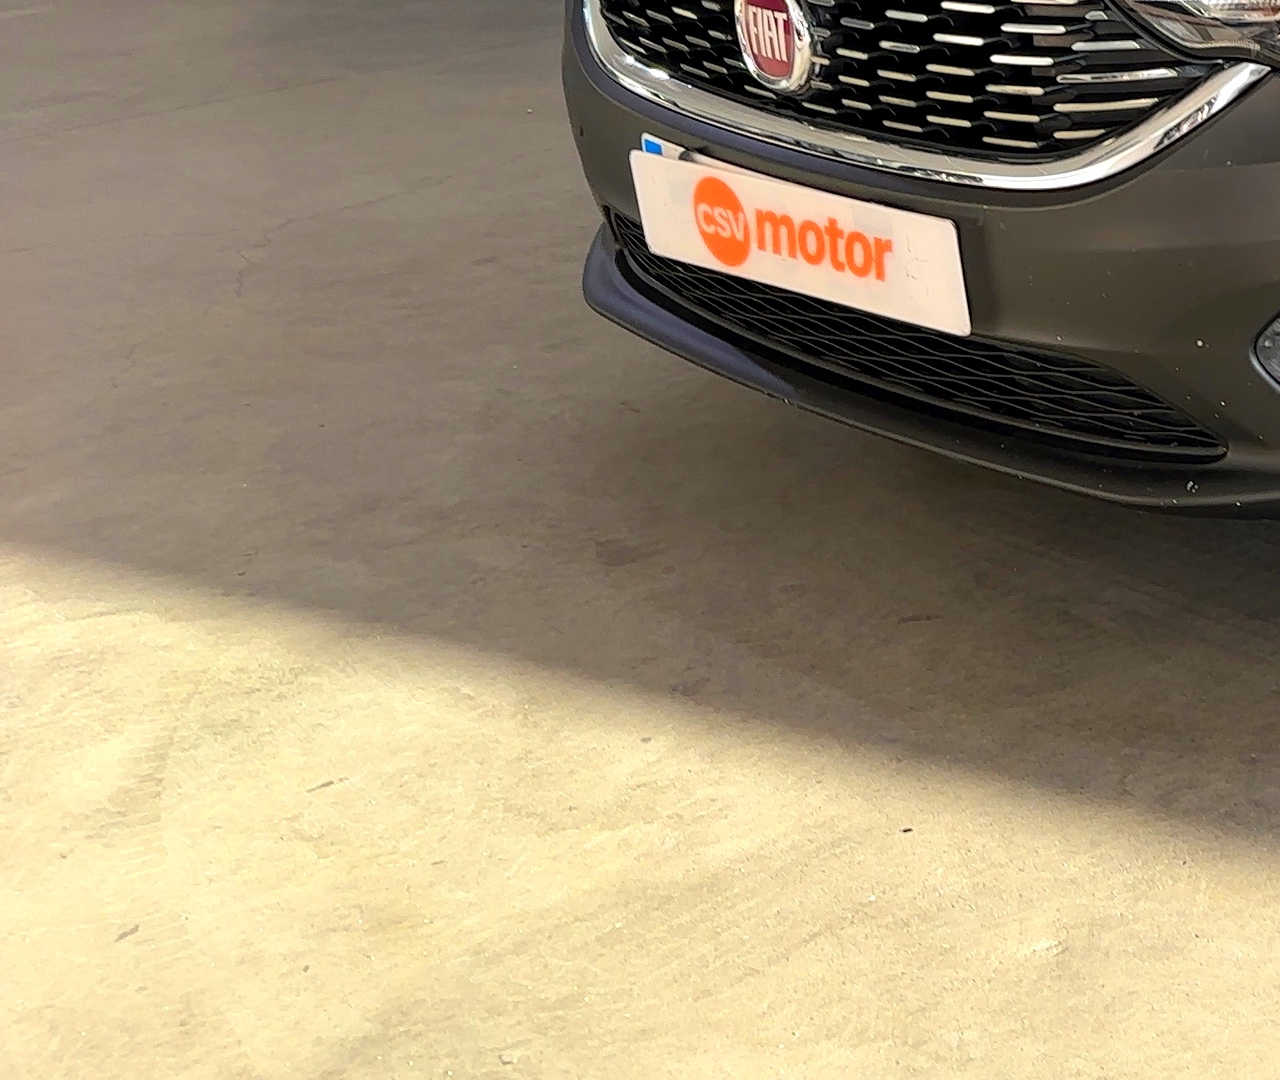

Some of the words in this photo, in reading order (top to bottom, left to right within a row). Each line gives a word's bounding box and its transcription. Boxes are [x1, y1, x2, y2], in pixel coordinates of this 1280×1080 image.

[747, 4, 788, 62] FIAT
[697, 203, 745, 242] CSV
[755, 208, 893, 282] motor
